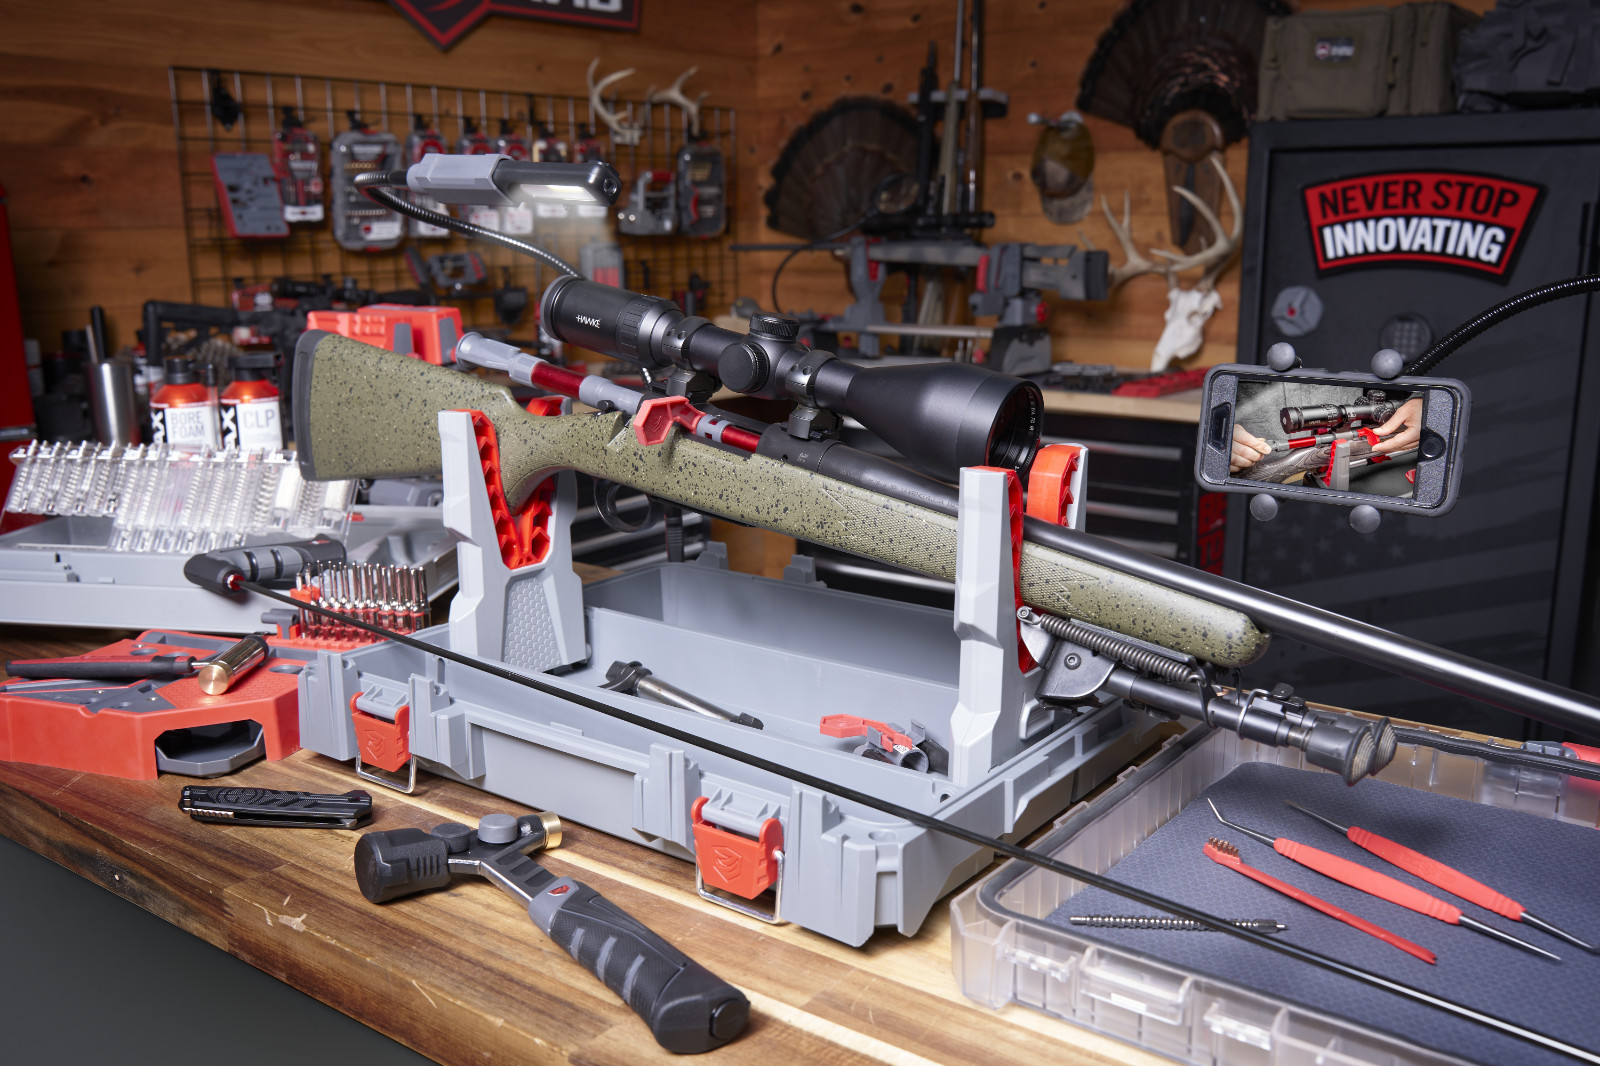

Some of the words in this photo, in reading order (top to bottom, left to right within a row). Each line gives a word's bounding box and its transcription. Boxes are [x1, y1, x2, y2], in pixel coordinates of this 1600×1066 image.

[1318, 179, 1422, 219] NEVER
[1431, 180, 1520, 218] STOP
[1322, 216, 1506, 263] INNOVATING
[576, 314, 600, 329] HAWKE
[170, 411, 203, 425] BORE
[243, 409, 276, 429] CLP
[171, 425, 206, 439] FOAM
